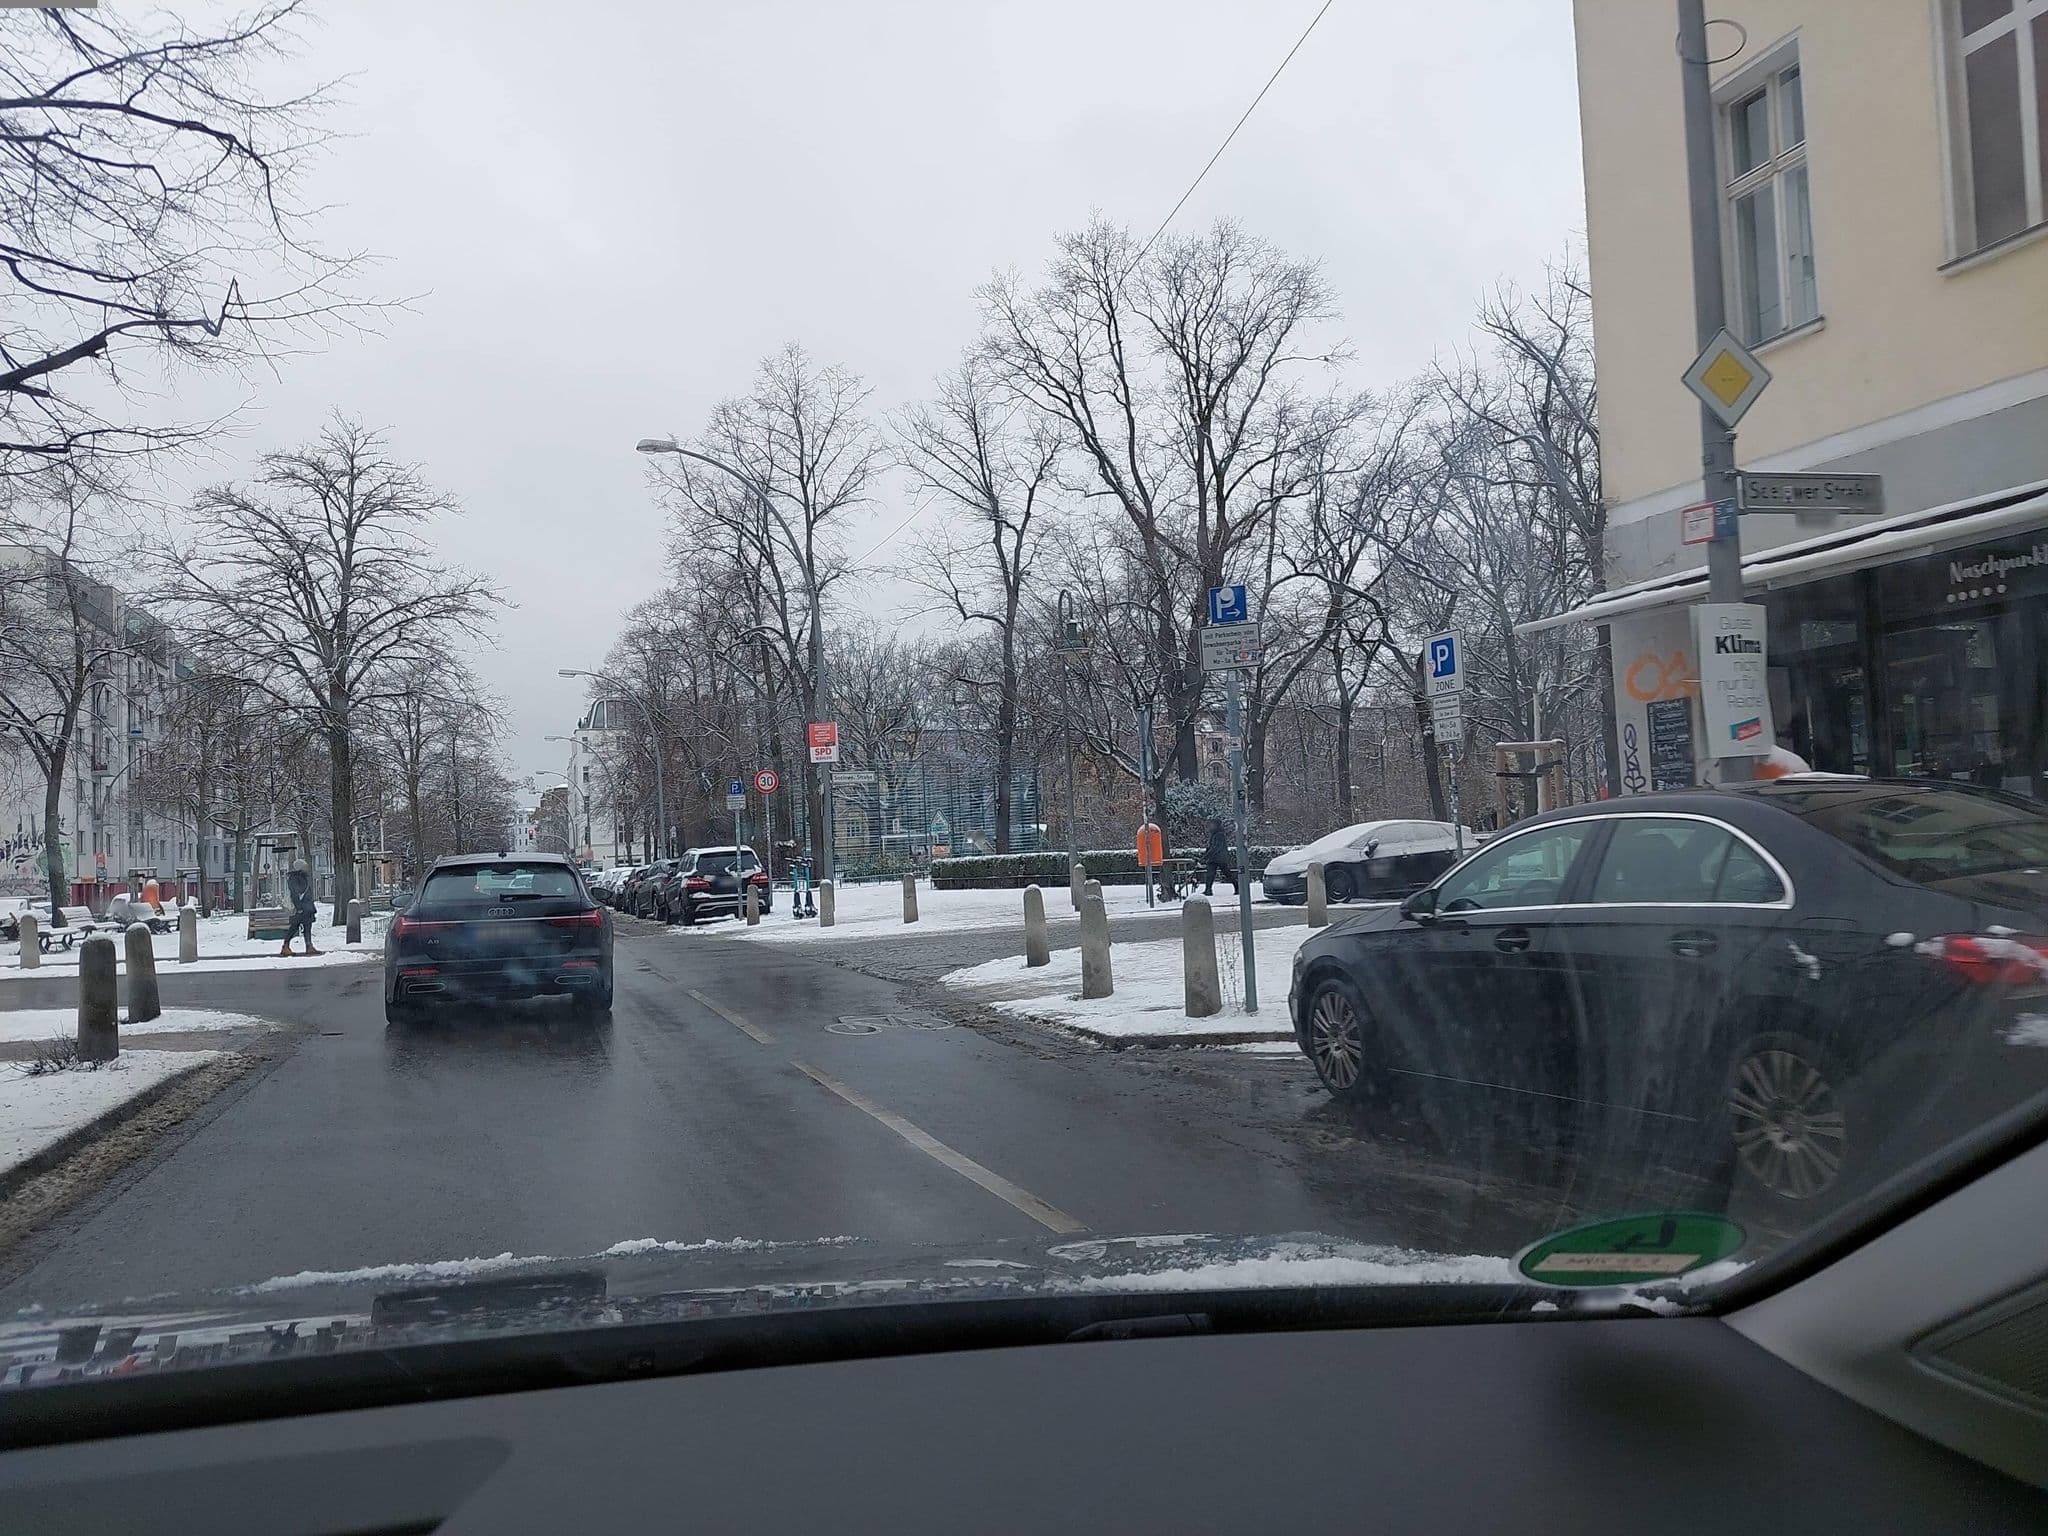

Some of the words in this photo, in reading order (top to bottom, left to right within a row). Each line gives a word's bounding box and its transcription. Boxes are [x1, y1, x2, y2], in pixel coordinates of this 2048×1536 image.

[1436, 644, 1449, 672] P
[1435, 679, 1455, 692] ZONE
[815, 747, 832, 756] SPD
[760, 776, 773, 787] 30
